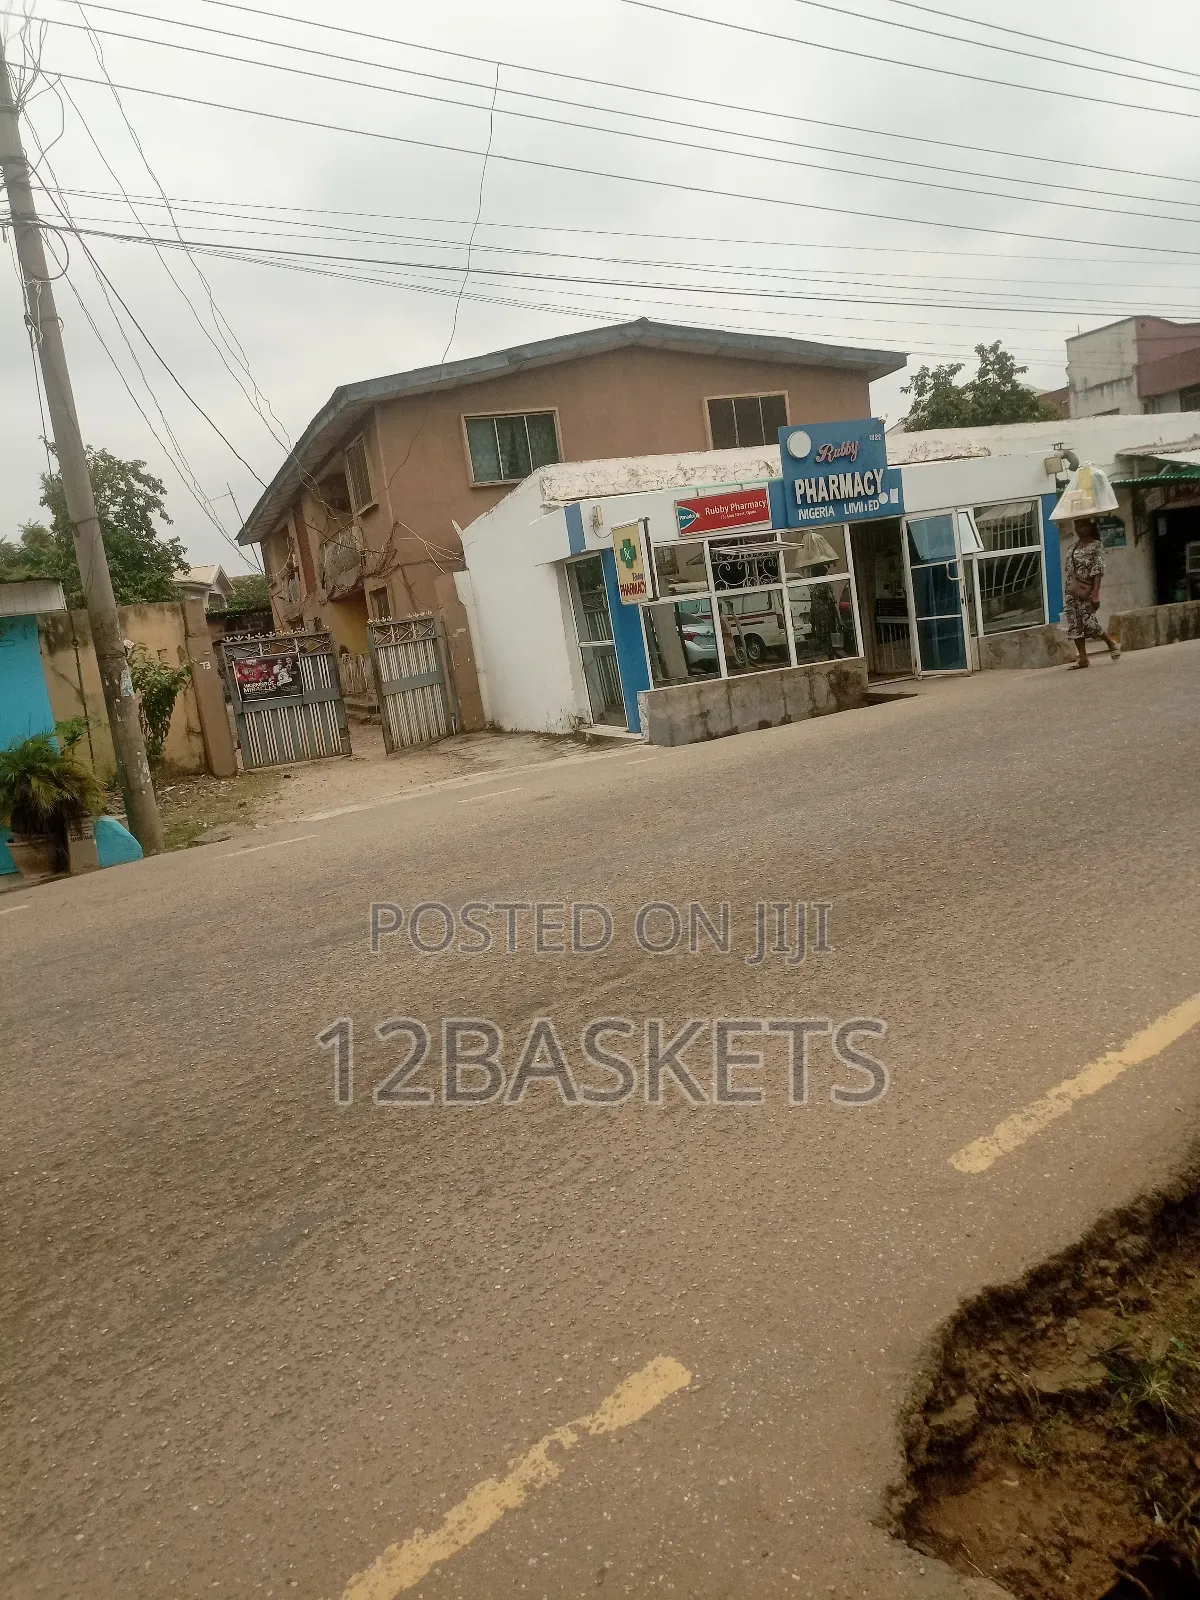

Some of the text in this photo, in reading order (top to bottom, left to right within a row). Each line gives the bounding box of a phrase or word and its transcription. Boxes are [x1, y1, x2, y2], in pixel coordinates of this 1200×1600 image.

[815, 441, 859, 463] Rubby
[794, 468, 884, 505] PHARMACY
[705, 504, 729, 516] Rubby
[730, 499, 767, 512] Pharmacy
[798, 505, 835, 520] NIGERIA
[620, 580, 647, 597] PHARMACY
